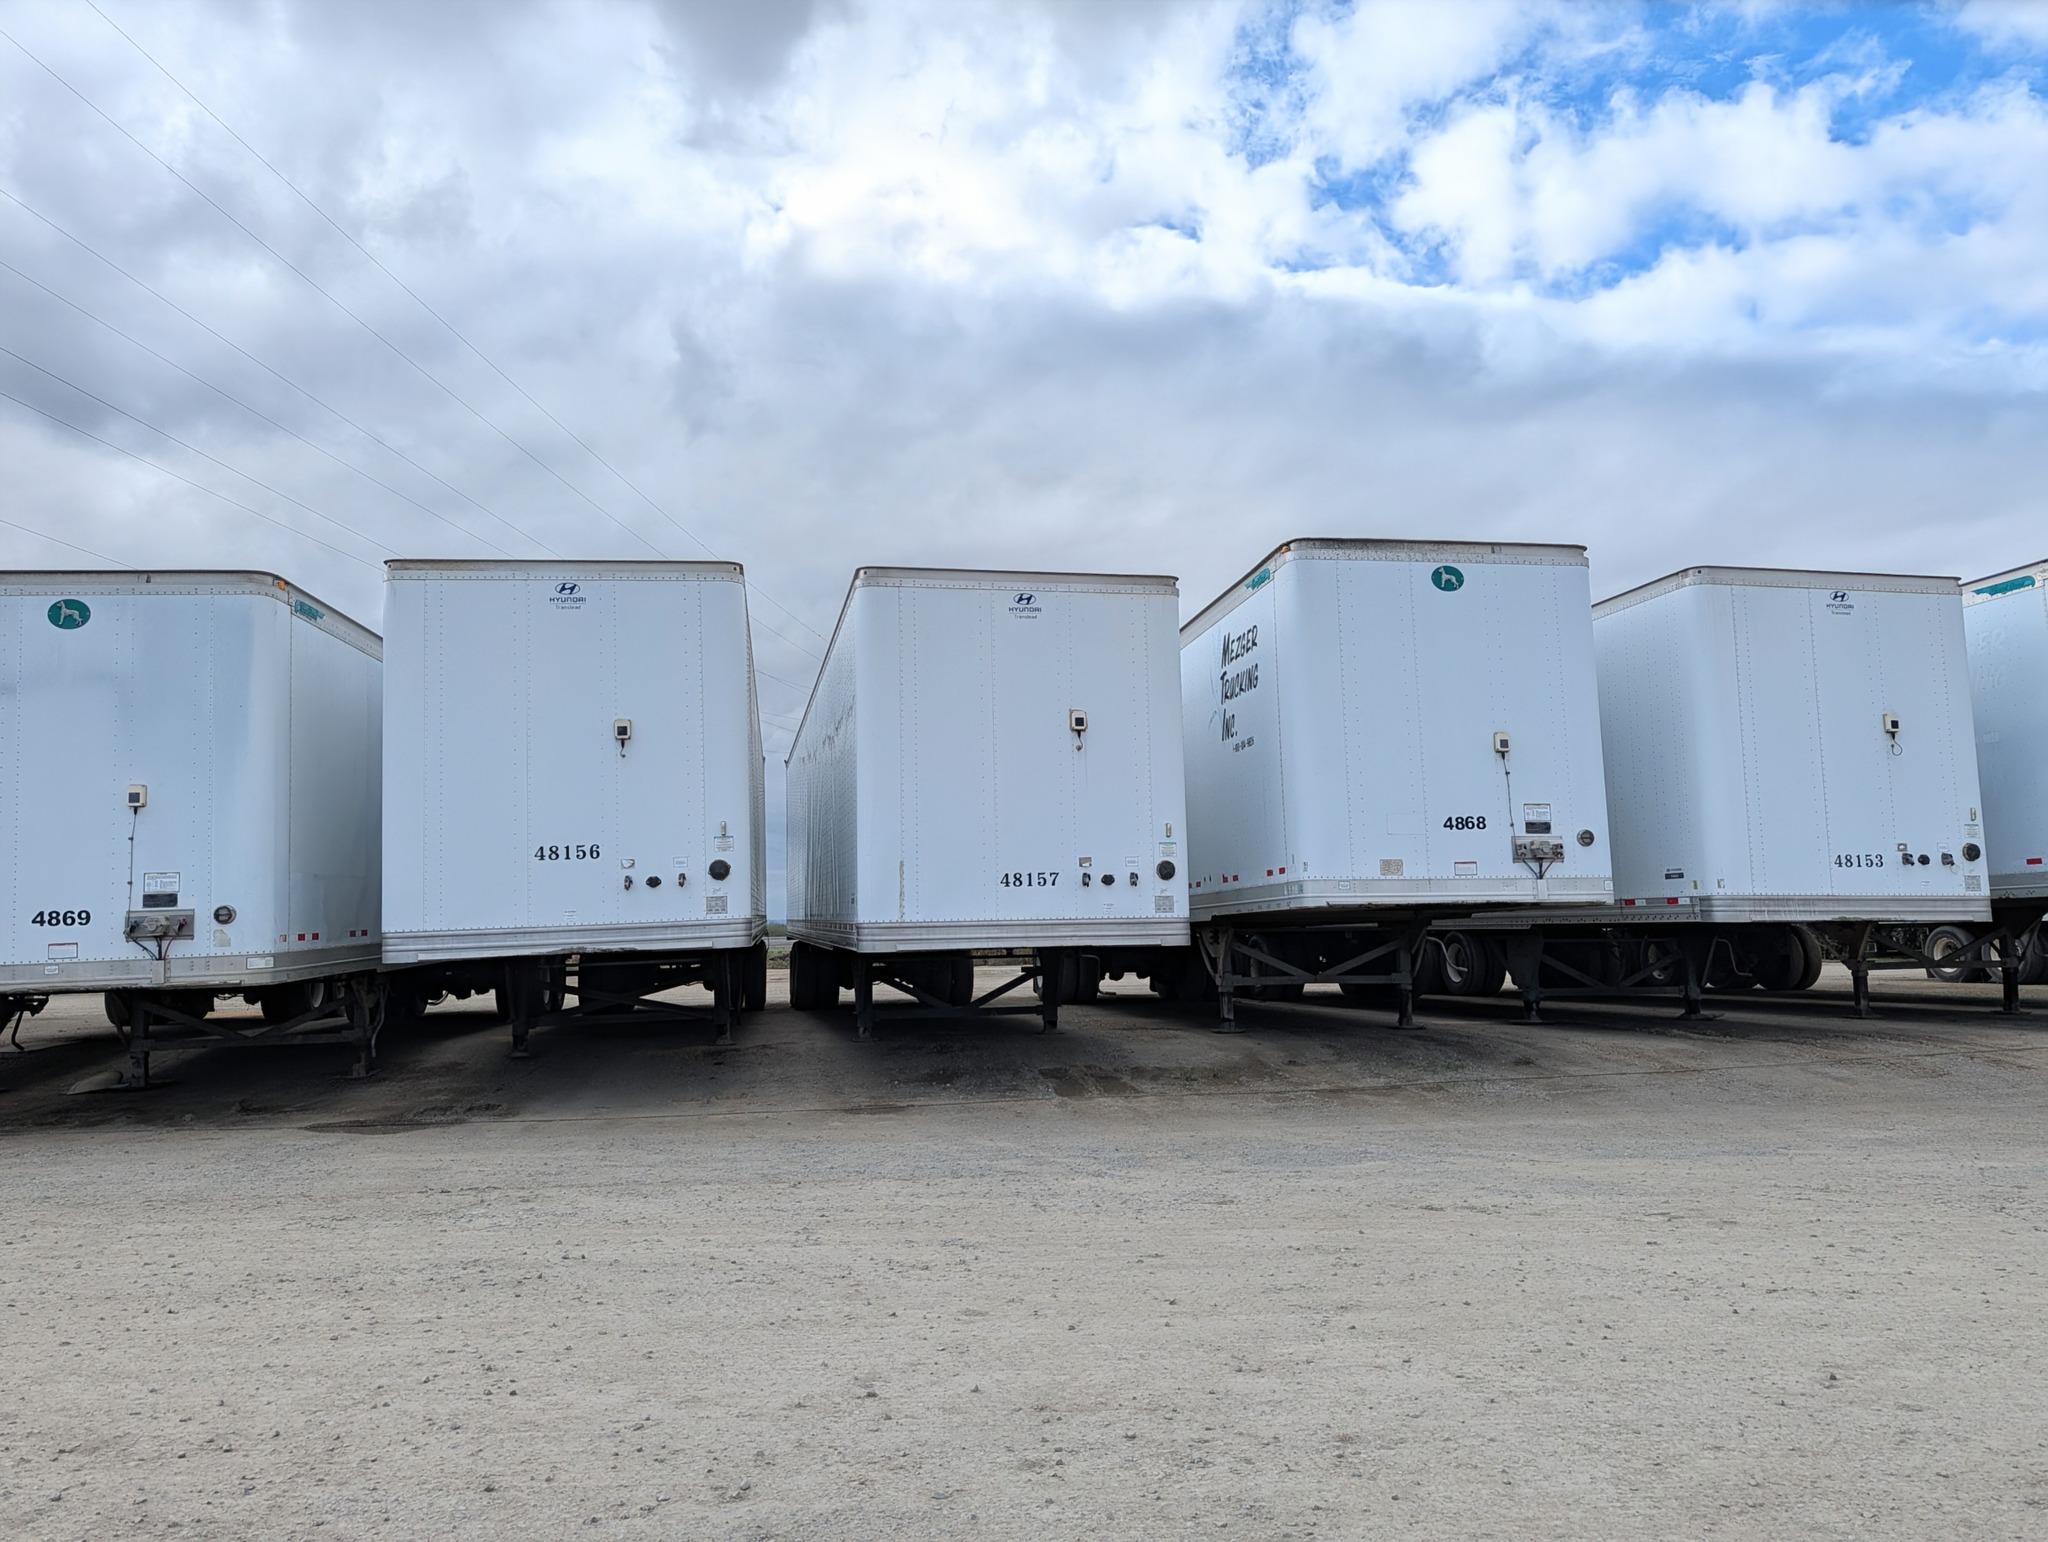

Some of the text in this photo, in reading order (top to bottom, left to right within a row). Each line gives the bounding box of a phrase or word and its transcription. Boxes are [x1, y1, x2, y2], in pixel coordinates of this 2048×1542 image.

[1221, 624, 1258, 669] MEZGER
[1219, 663, 1259, 705] TRUCKING
[1221, 708, 1238, 742] INC.
[1443, 816, 1487, 831] 4868
[534, 844, 601, 861] 48156
[1834, 853, 1884, 868] 48153
[999, 871, 1060, 888] 48157
[31, 909, 92, 927] 4869
